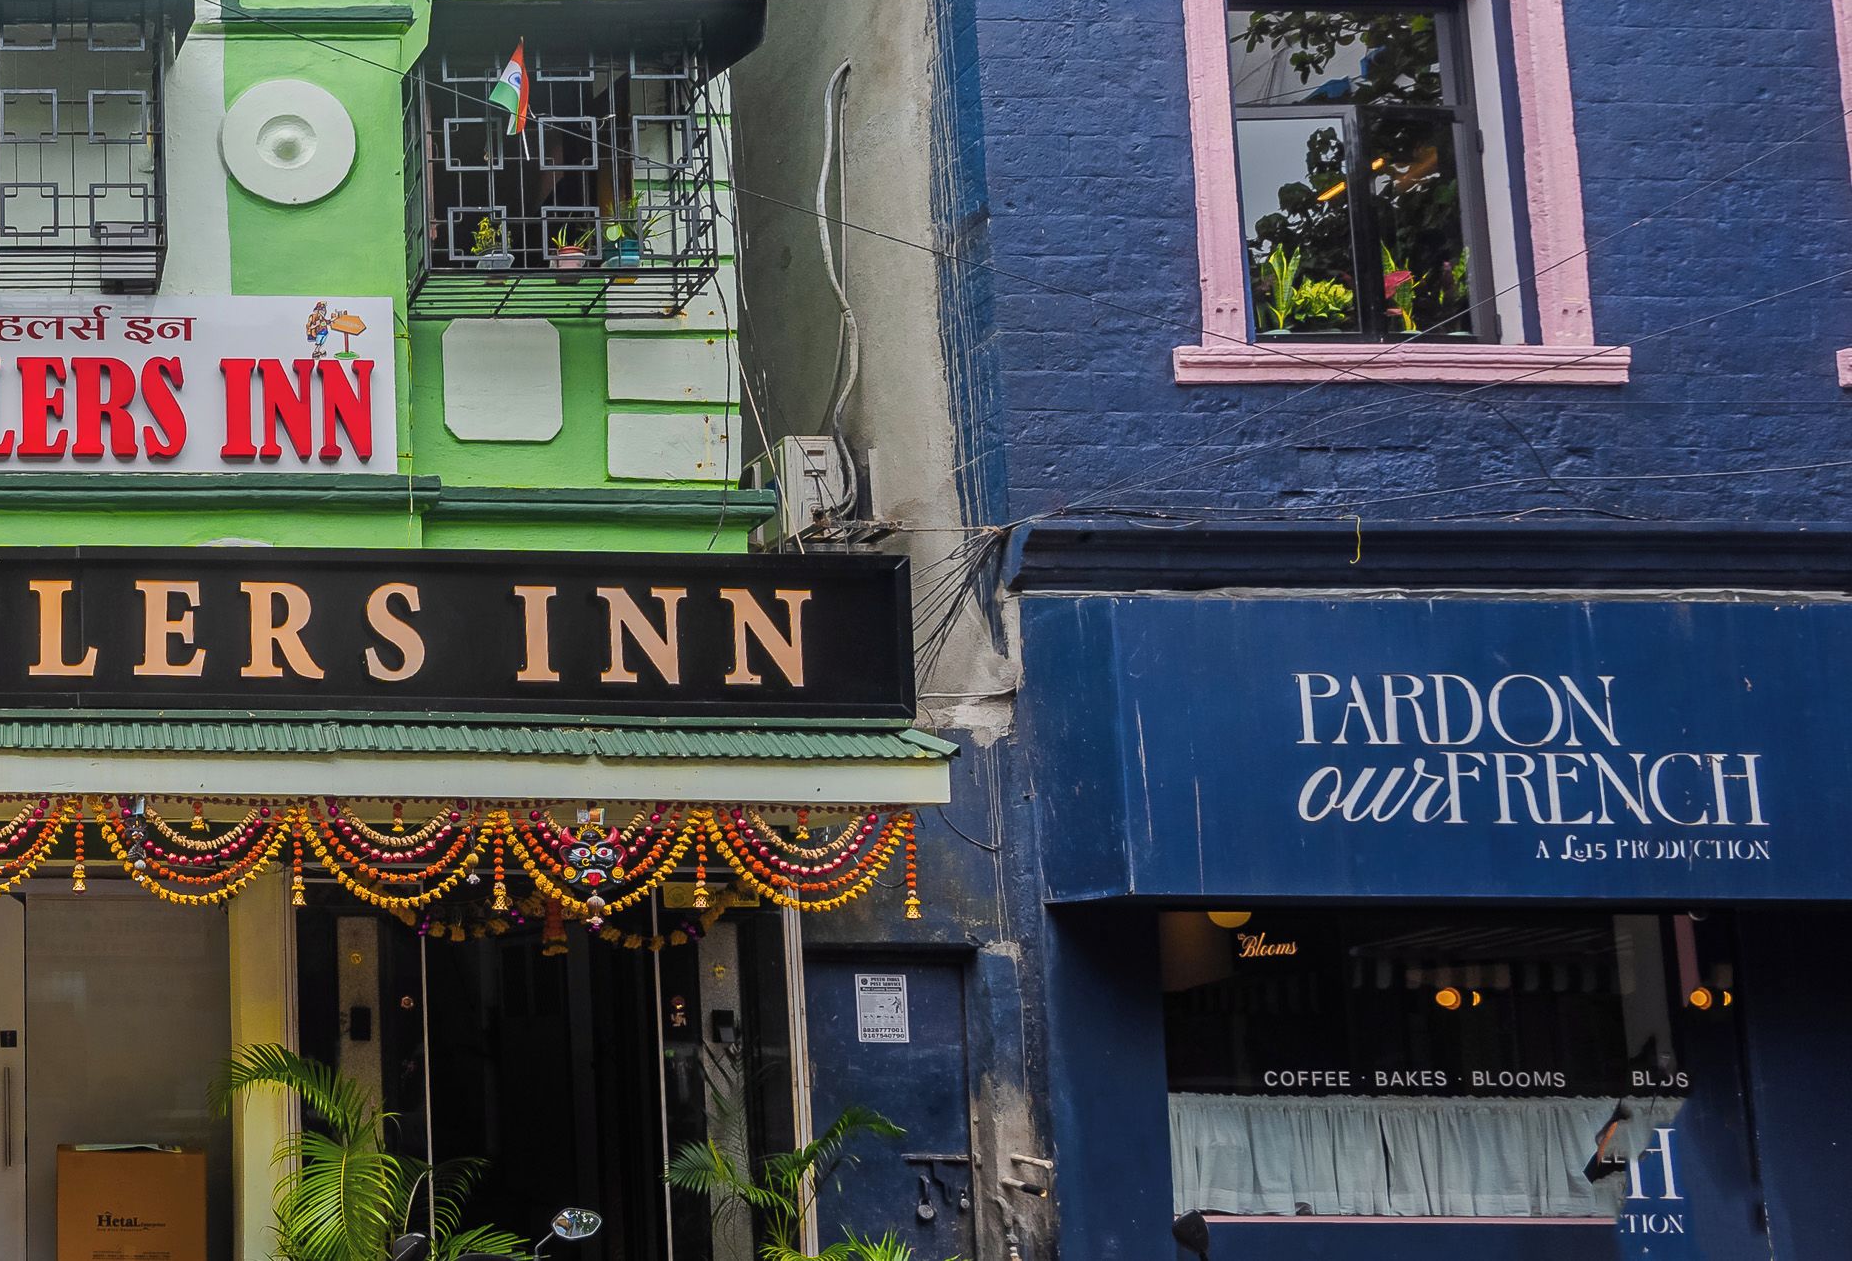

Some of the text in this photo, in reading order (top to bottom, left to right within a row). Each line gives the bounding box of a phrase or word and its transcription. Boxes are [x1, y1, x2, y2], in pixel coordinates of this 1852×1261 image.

[121, 316, 198, 345] इन
[219, 358, 376, 463] INN
[513, 584, 812, 688] INN
[1292, 672, 1621, 747] PARDON
[1440, 751, 1771, 826] FRENCH
[1535, 839, 1551, 859] A
[1616, 838, 1771, 861] PRODUCTION
[1238, 932, 1297, 958] Blooms
[1263, 1070, 1567, 1088] COFFEE BAKES BLOOMS
